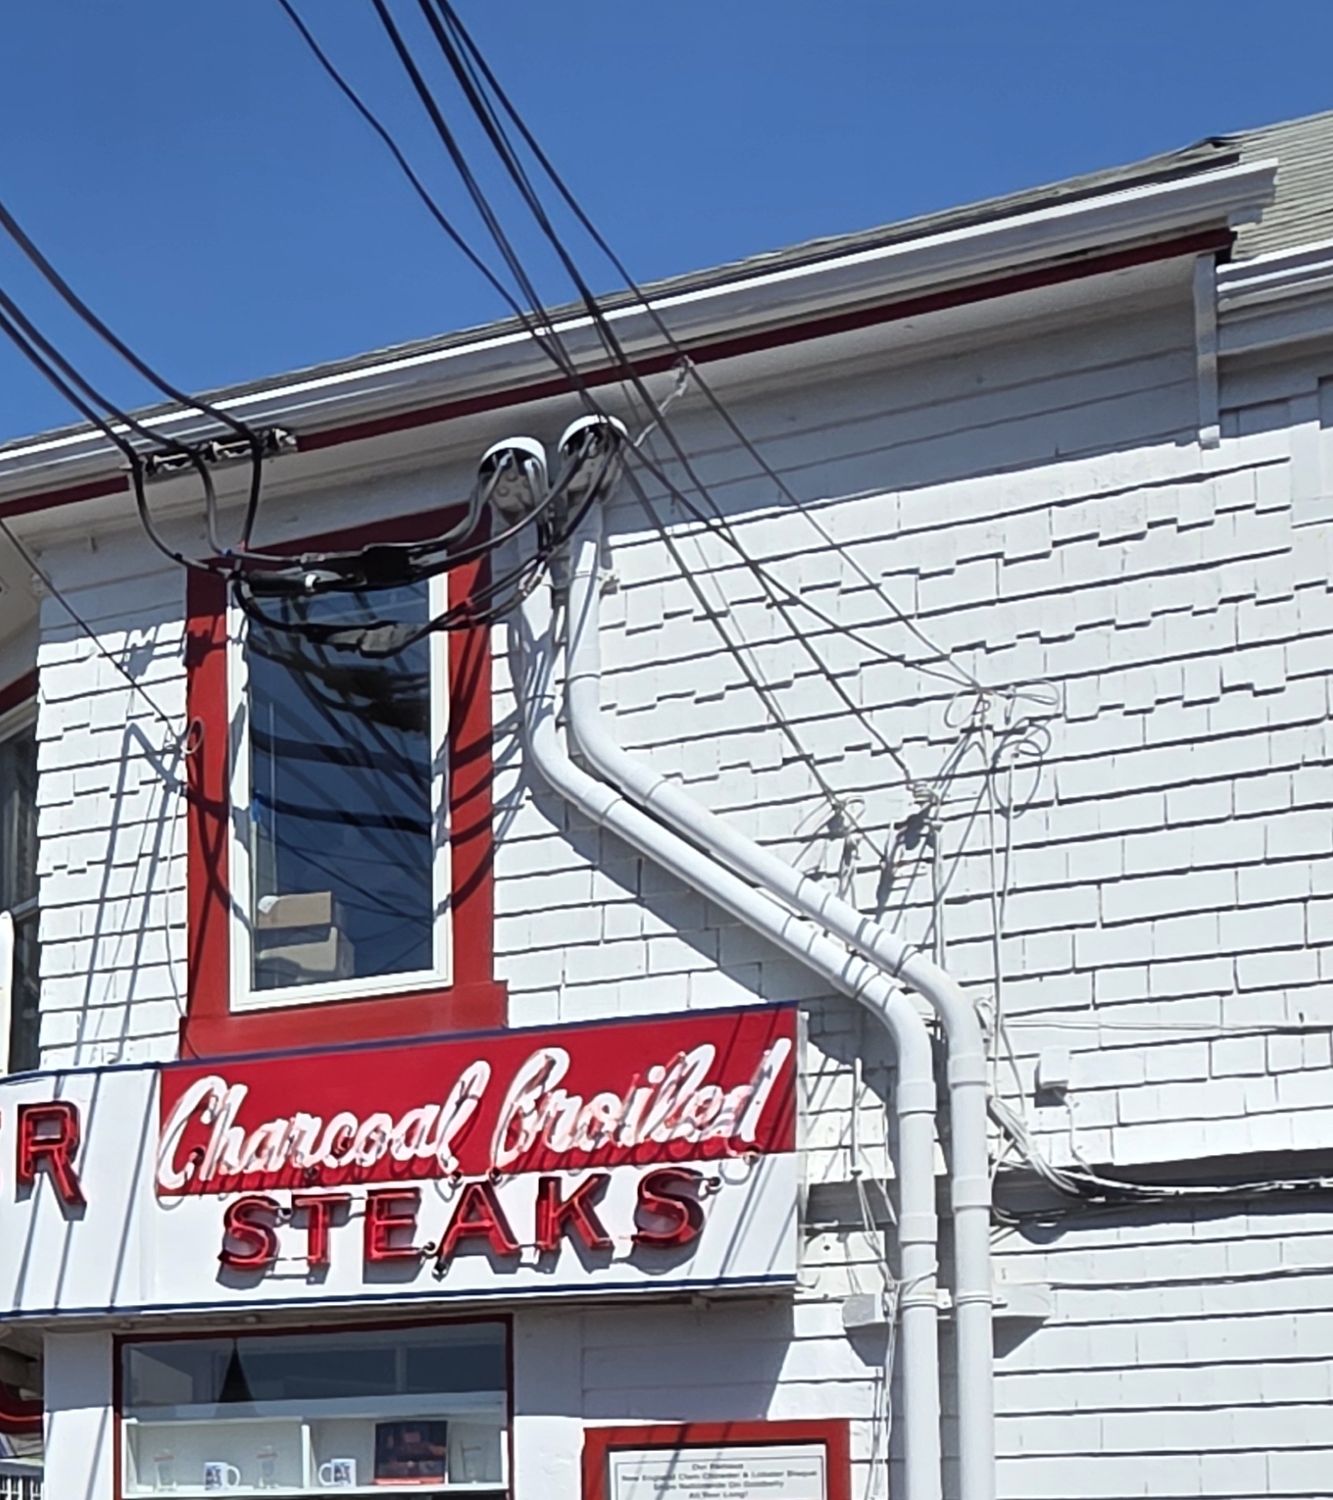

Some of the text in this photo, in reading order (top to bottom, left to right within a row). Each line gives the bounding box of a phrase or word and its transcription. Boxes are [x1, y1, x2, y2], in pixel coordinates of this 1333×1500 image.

[158, 1037, 792, 1190] Charcoal Broiled
[218, 1167, 706, 1270] STEAKS
